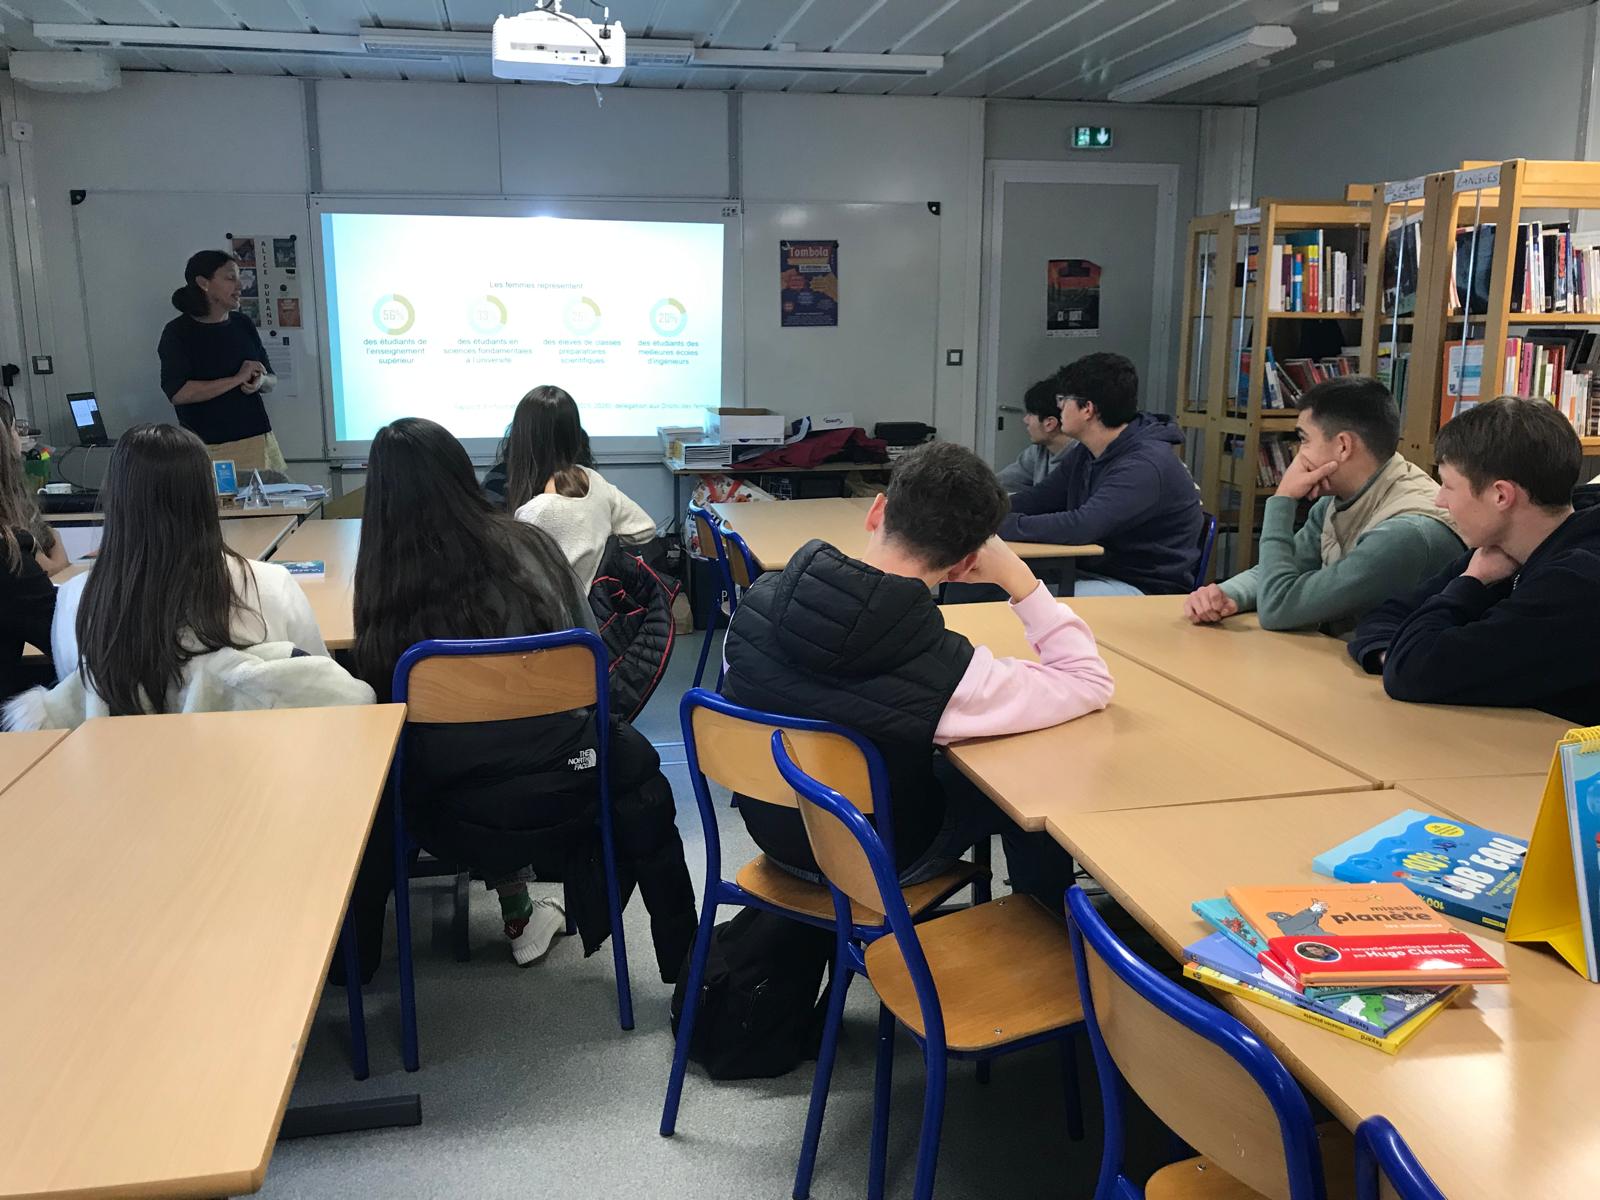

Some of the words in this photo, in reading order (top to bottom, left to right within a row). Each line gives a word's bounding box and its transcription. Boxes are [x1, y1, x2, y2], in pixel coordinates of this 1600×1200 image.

[790, 246, 829, 257] Tombola
[489, 281, 503, 289] Les
[505, 281, 535, 289] femmes
[264, 284, 273, 326] DURAND
[363, 338, 377, 346] des
[380, 337, 415, 346] étudiants
[417, 338, 427, 346] de
[457, 338, 471, 346] des
[473, 337, 507, 346] étudiants
[543, 338, 556, 346] des
[584, 338, 593, 346] de
[595, 339, 622, 347] classes
[637, 339, 650, 347] des
[653, 339, 684, 347] étudiants
[686, 340, 699, 348] des
[366, 347, 425, 357] l'enseignement
[443, 347, 476, 355] sciences
[478, 347, 533, 356] fondamentales
[638, 348, 674, 357] meilleures
[676, 348, 699, 357] écoles
[379, 356, 415, 366] supérieur
[648, 357, 690, 367] d'ingénieurs
[579, 750, 590, 758] THE
[568, 757, 588, 766] NORTH
[574, 763, 588, 771] FACE
[1369, 903, 1424, 912] mission
[1330, 909, 1432, 925] planète
[1352, 945, 1384, 953] nouvelle
[1384, 943, 1422, 952] collection
[1422, 943, 1440, 952] pour
[1441, 942, 1470, 950] enfants
[1366, 949, 1406, 960] Hugo
[1408, 946, 1472, 957] Clément
[1361, 1034, 1382, 1048] fayard
